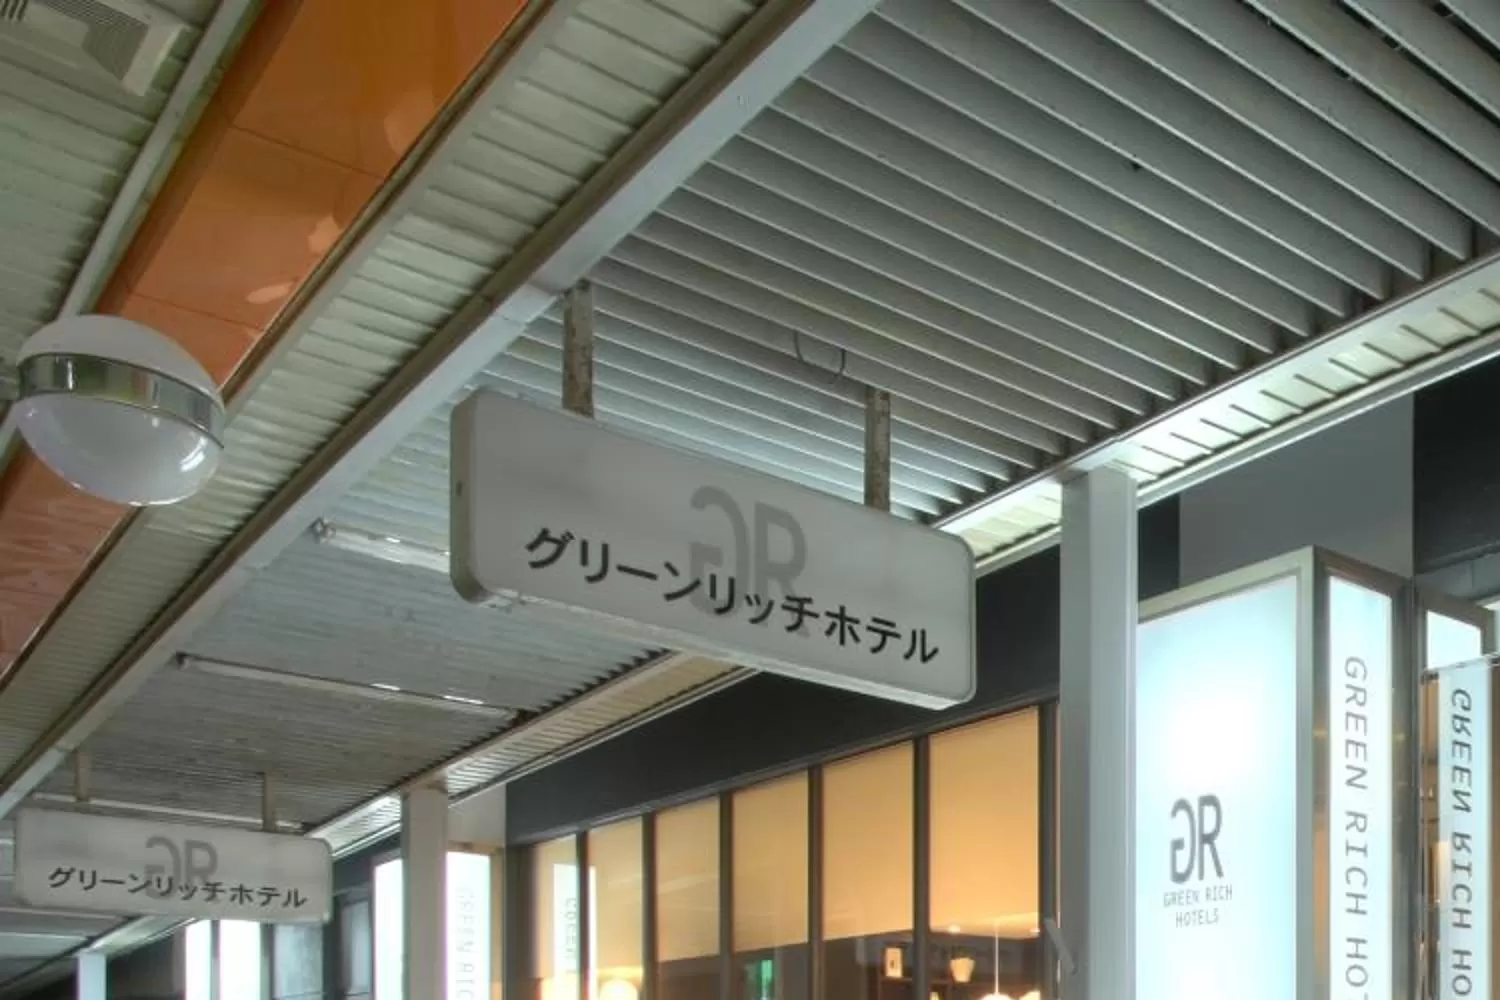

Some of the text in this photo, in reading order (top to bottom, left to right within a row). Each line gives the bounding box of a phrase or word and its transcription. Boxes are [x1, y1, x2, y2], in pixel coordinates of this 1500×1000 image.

[525, 527, 939, 664] グリーンリッチホテル
[1344, 656, 1368, 790] GREEN
[48, 867, 308, 908] グリーンリッチホテル
[1163, 884, 1233, 908] GREEN RICH
[1344, 810, 1368, 916] RICH
[1175, 908, 1219, 928] HOTELS
